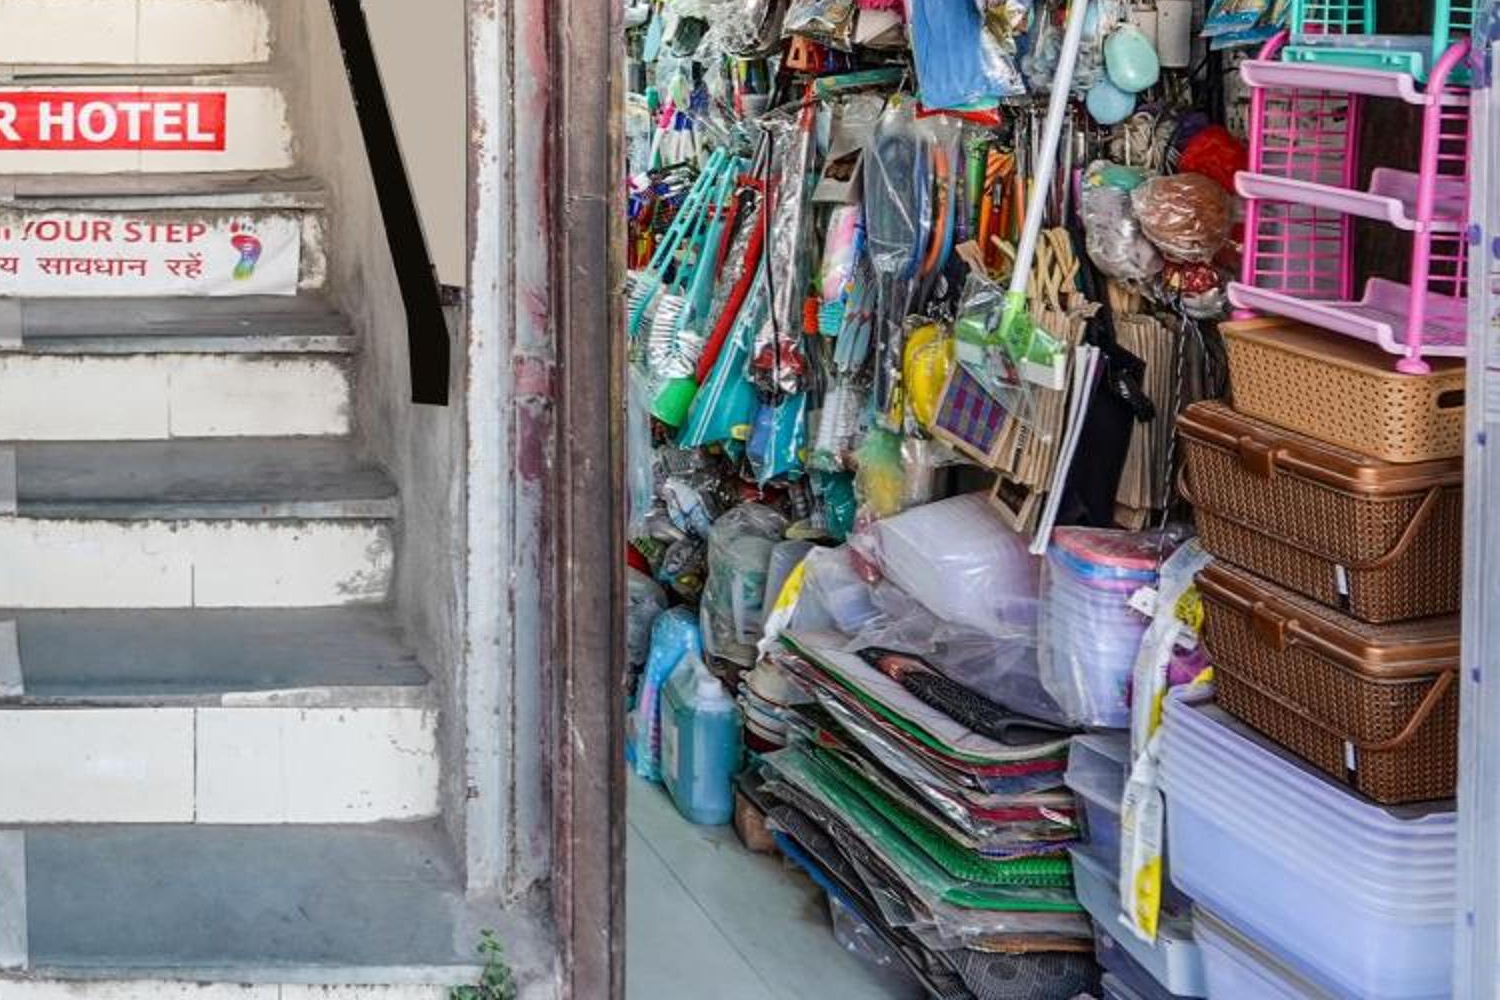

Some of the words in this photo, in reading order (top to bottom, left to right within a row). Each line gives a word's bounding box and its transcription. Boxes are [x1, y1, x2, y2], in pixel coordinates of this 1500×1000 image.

[39, 101, 216, 142] HOTEL
[37, 256, 149, 276] सावधान
[164, 250, 202, 279] रहें
